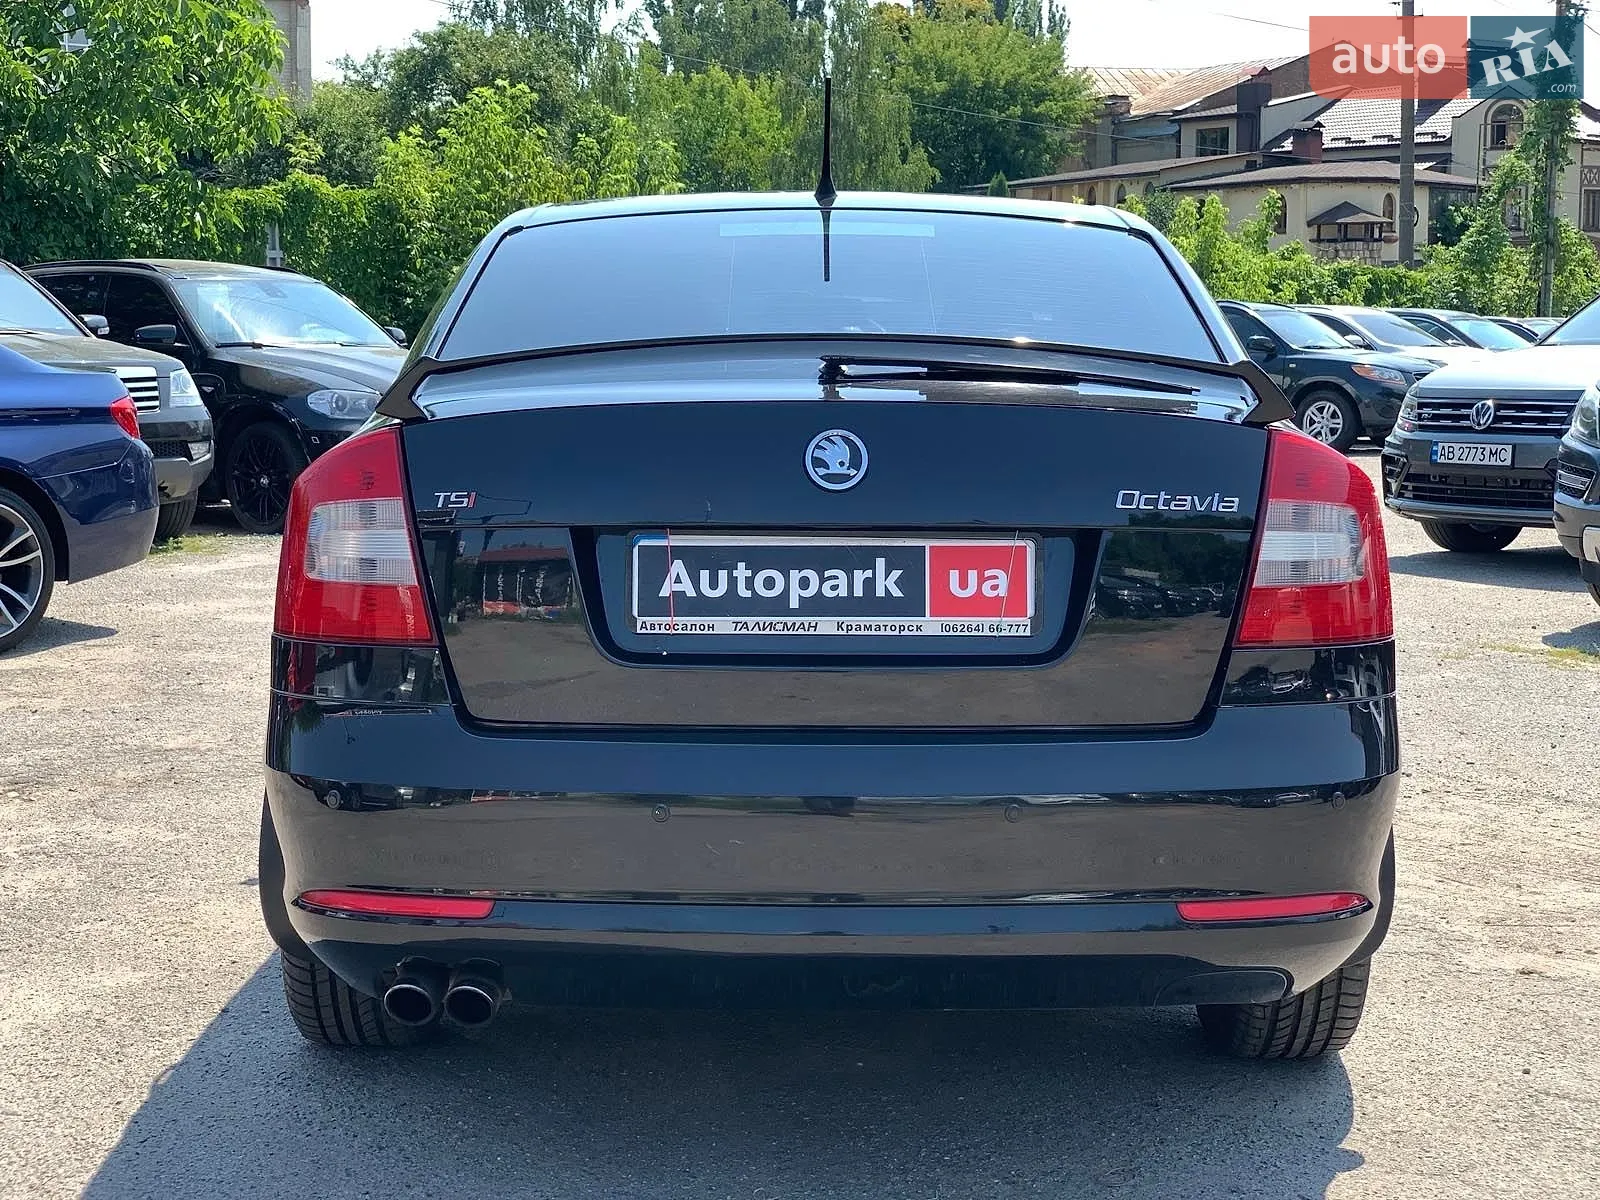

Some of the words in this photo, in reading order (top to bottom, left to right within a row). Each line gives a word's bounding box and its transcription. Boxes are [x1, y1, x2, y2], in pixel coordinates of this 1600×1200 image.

[1439, 445, 1455, 461] AB
[1457, 446, 1486, 462] 2773
[1489, 447, 1508, 463] MC
[1115, 490, 1240, 512] Octavia
[658, 558, 904, 609] Autopark
[948, 569, 1008, 598] ua
[639, 621, 715, 632] Автосалон
[731, 621, 818, 632] ТАЛИСМАН
[836, 621, 923, 634] Краматорск
[988, 623, 1029, 633] 66-777
